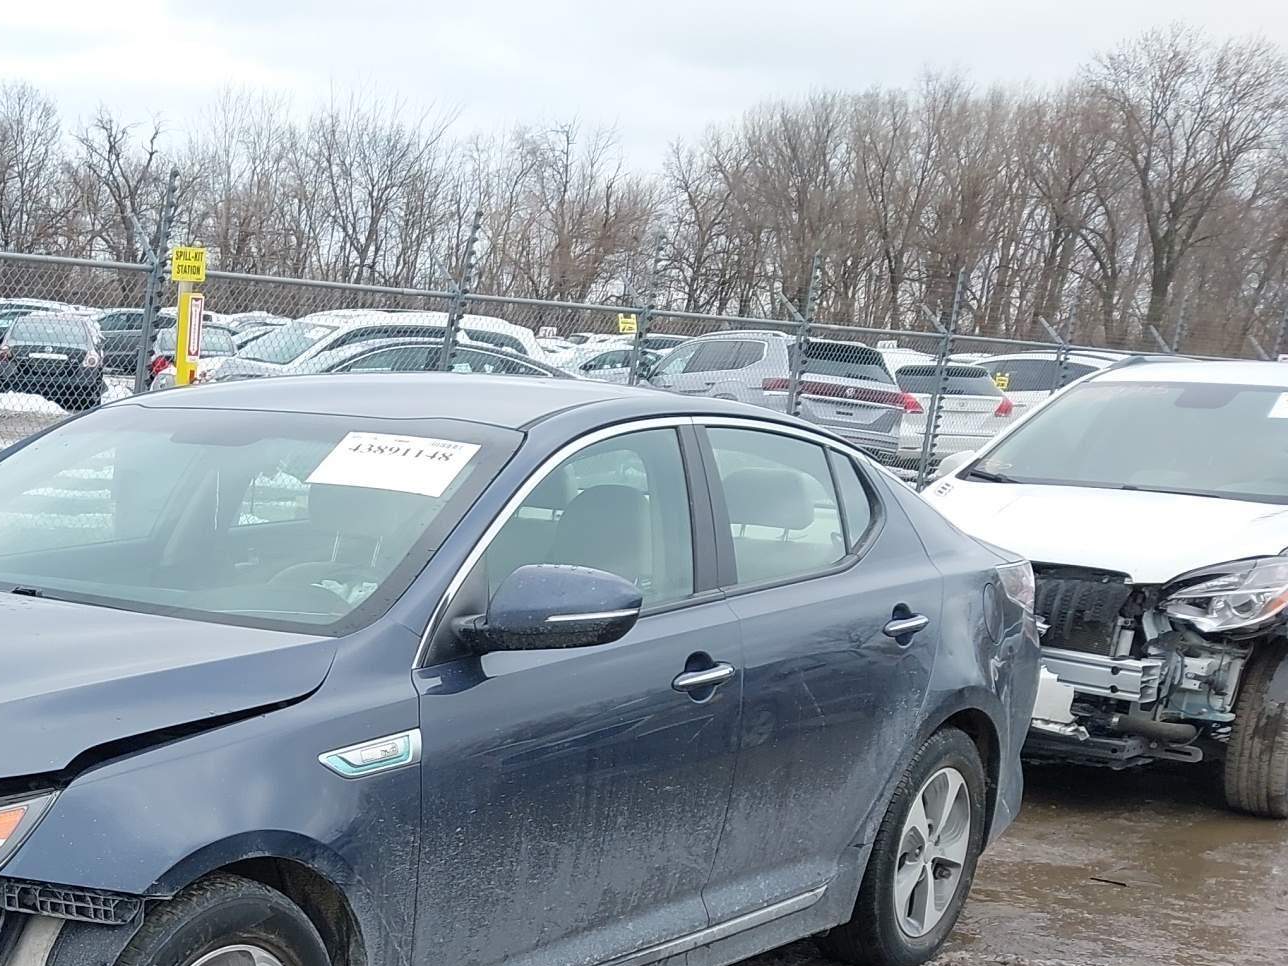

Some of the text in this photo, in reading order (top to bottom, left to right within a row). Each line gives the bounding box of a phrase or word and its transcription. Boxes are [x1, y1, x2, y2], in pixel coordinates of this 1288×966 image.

[175, 250, 204, 262] SPILL-KIT
[176, 264, 201, 275] STATION
[348, 442, 454, 463] 43891148
